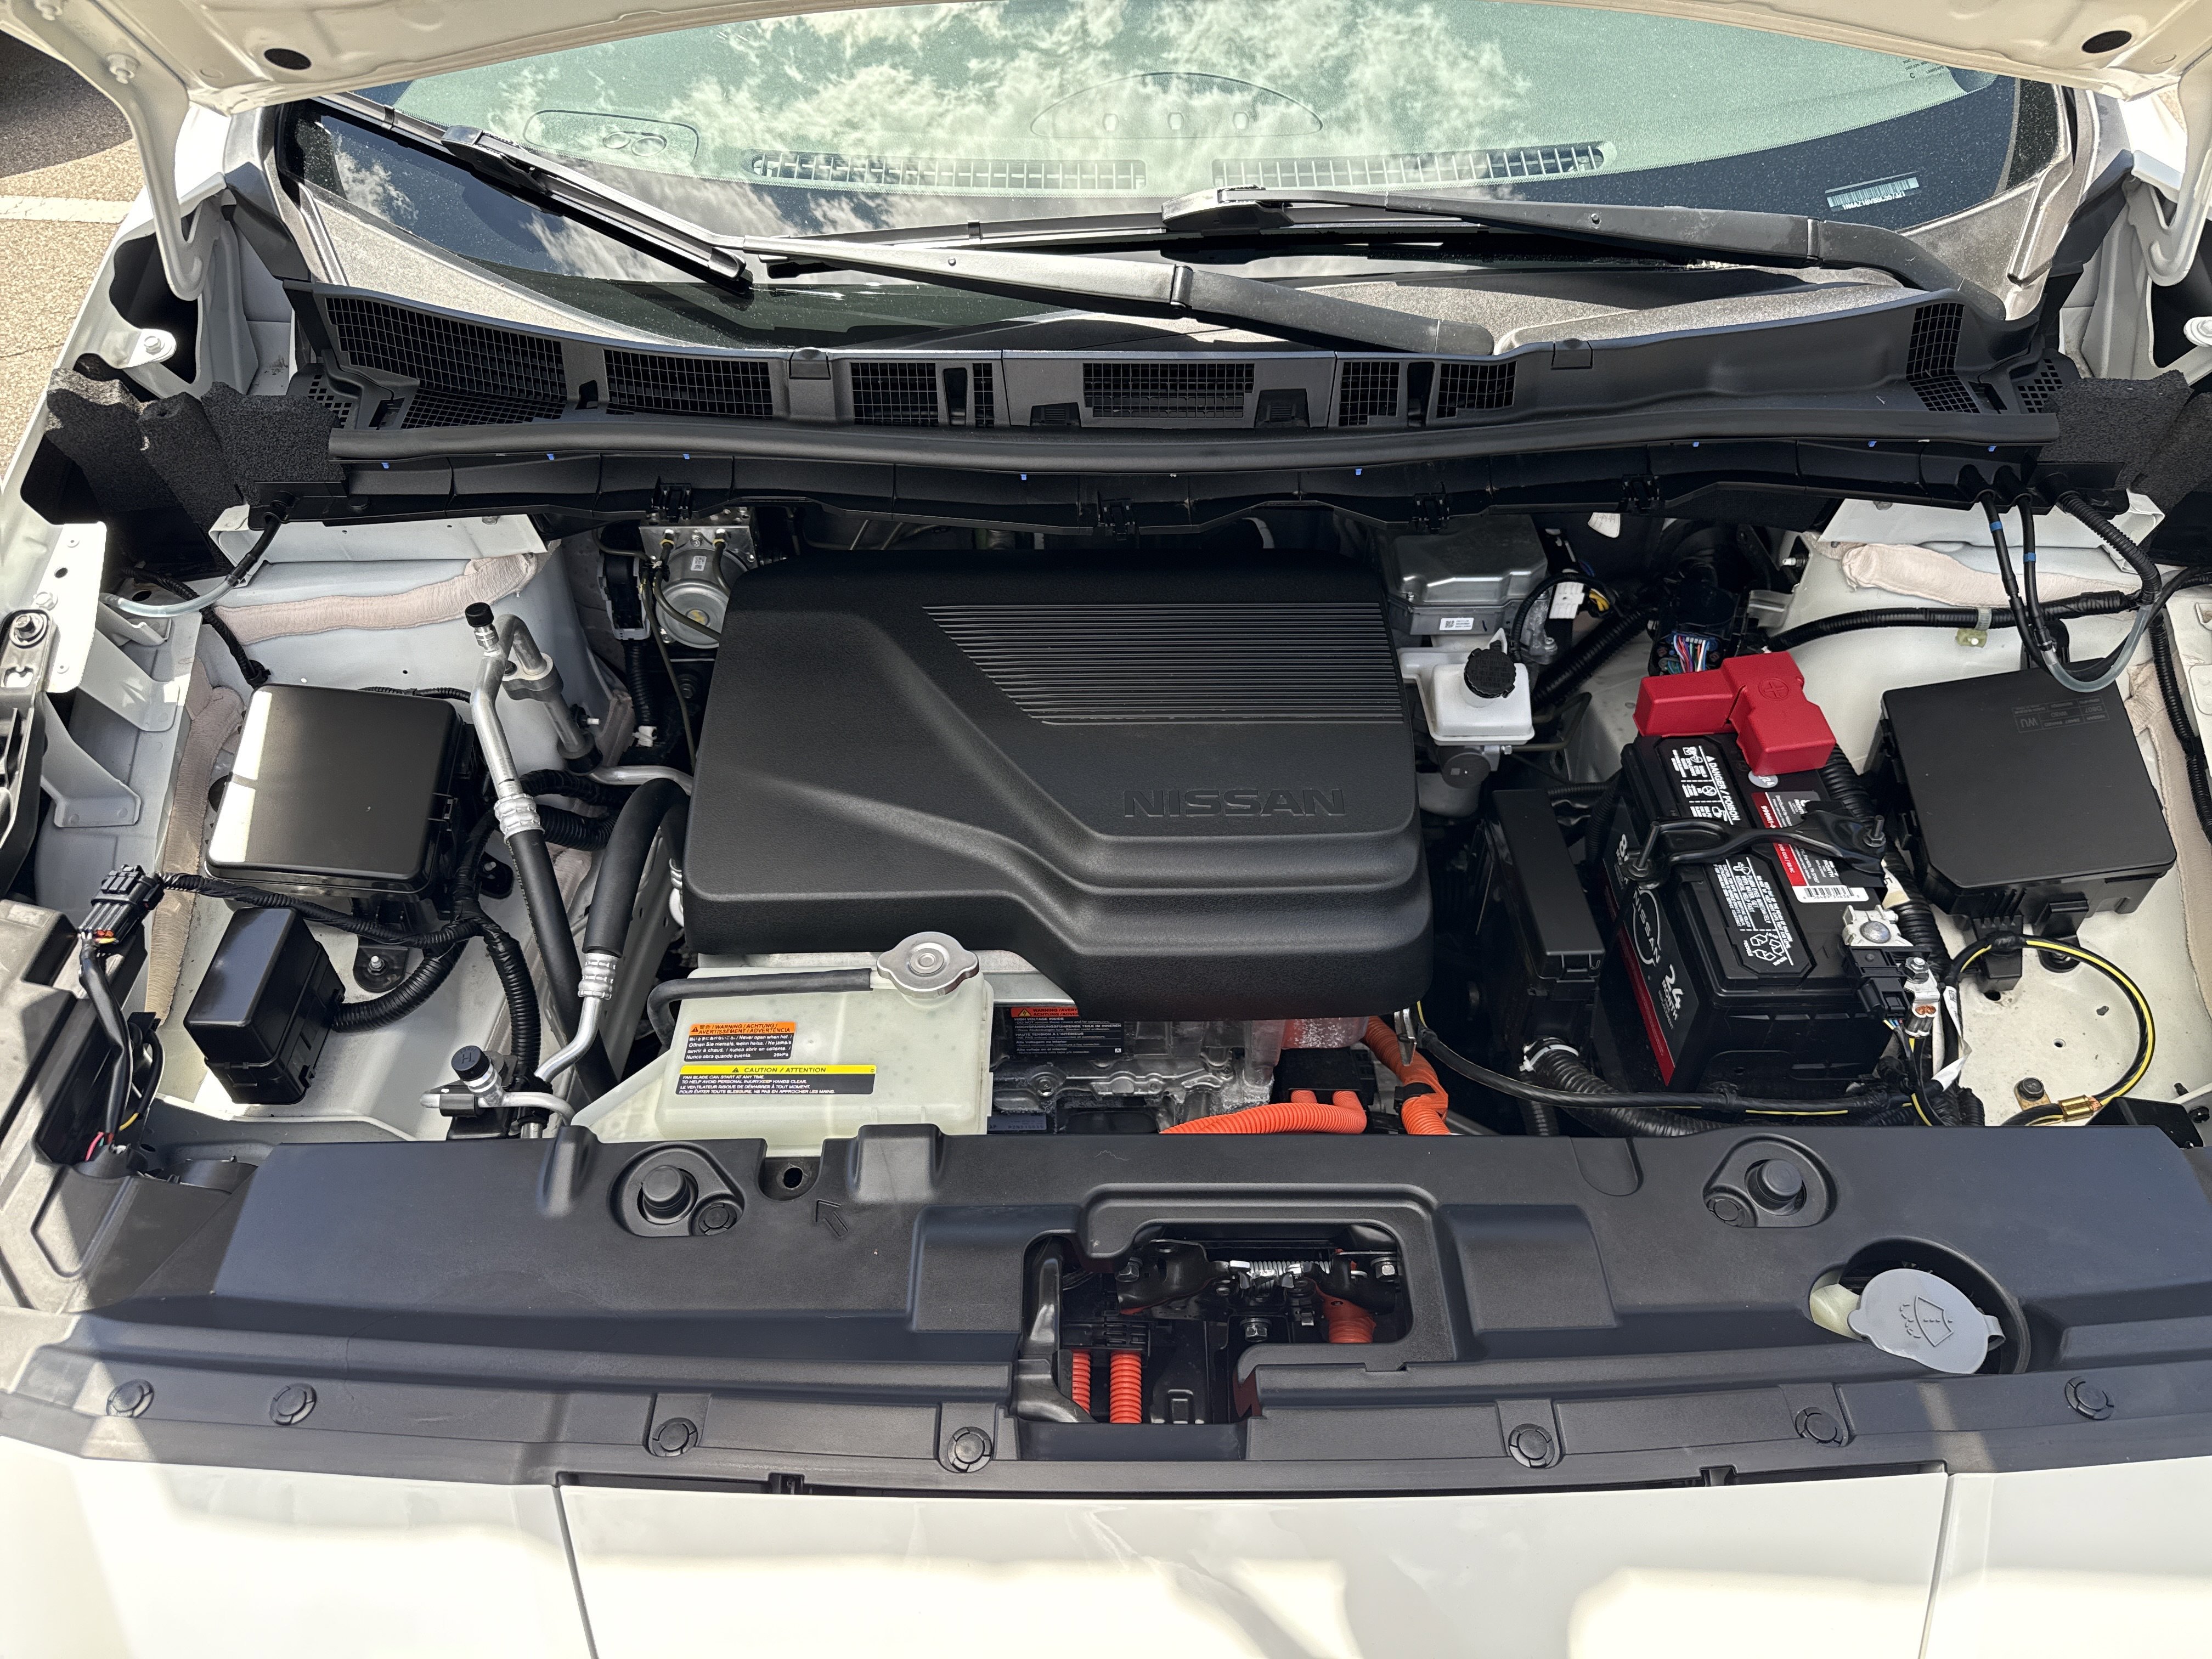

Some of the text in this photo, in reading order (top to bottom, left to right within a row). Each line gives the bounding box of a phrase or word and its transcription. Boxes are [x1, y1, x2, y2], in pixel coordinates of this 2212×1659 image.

[1124, 789, 1345, 818] NISSAN
[1708, 763, 1727, 789] DANGER
[1722, 795, 1741, 820] POISON
[1822, 860, 1835, 877] MONTH
[1633, 890, 1660, 963] NISSAN
[1662, 979, 1678, 1020] MONTH
[1666, 964, 1684, 1009] 24
